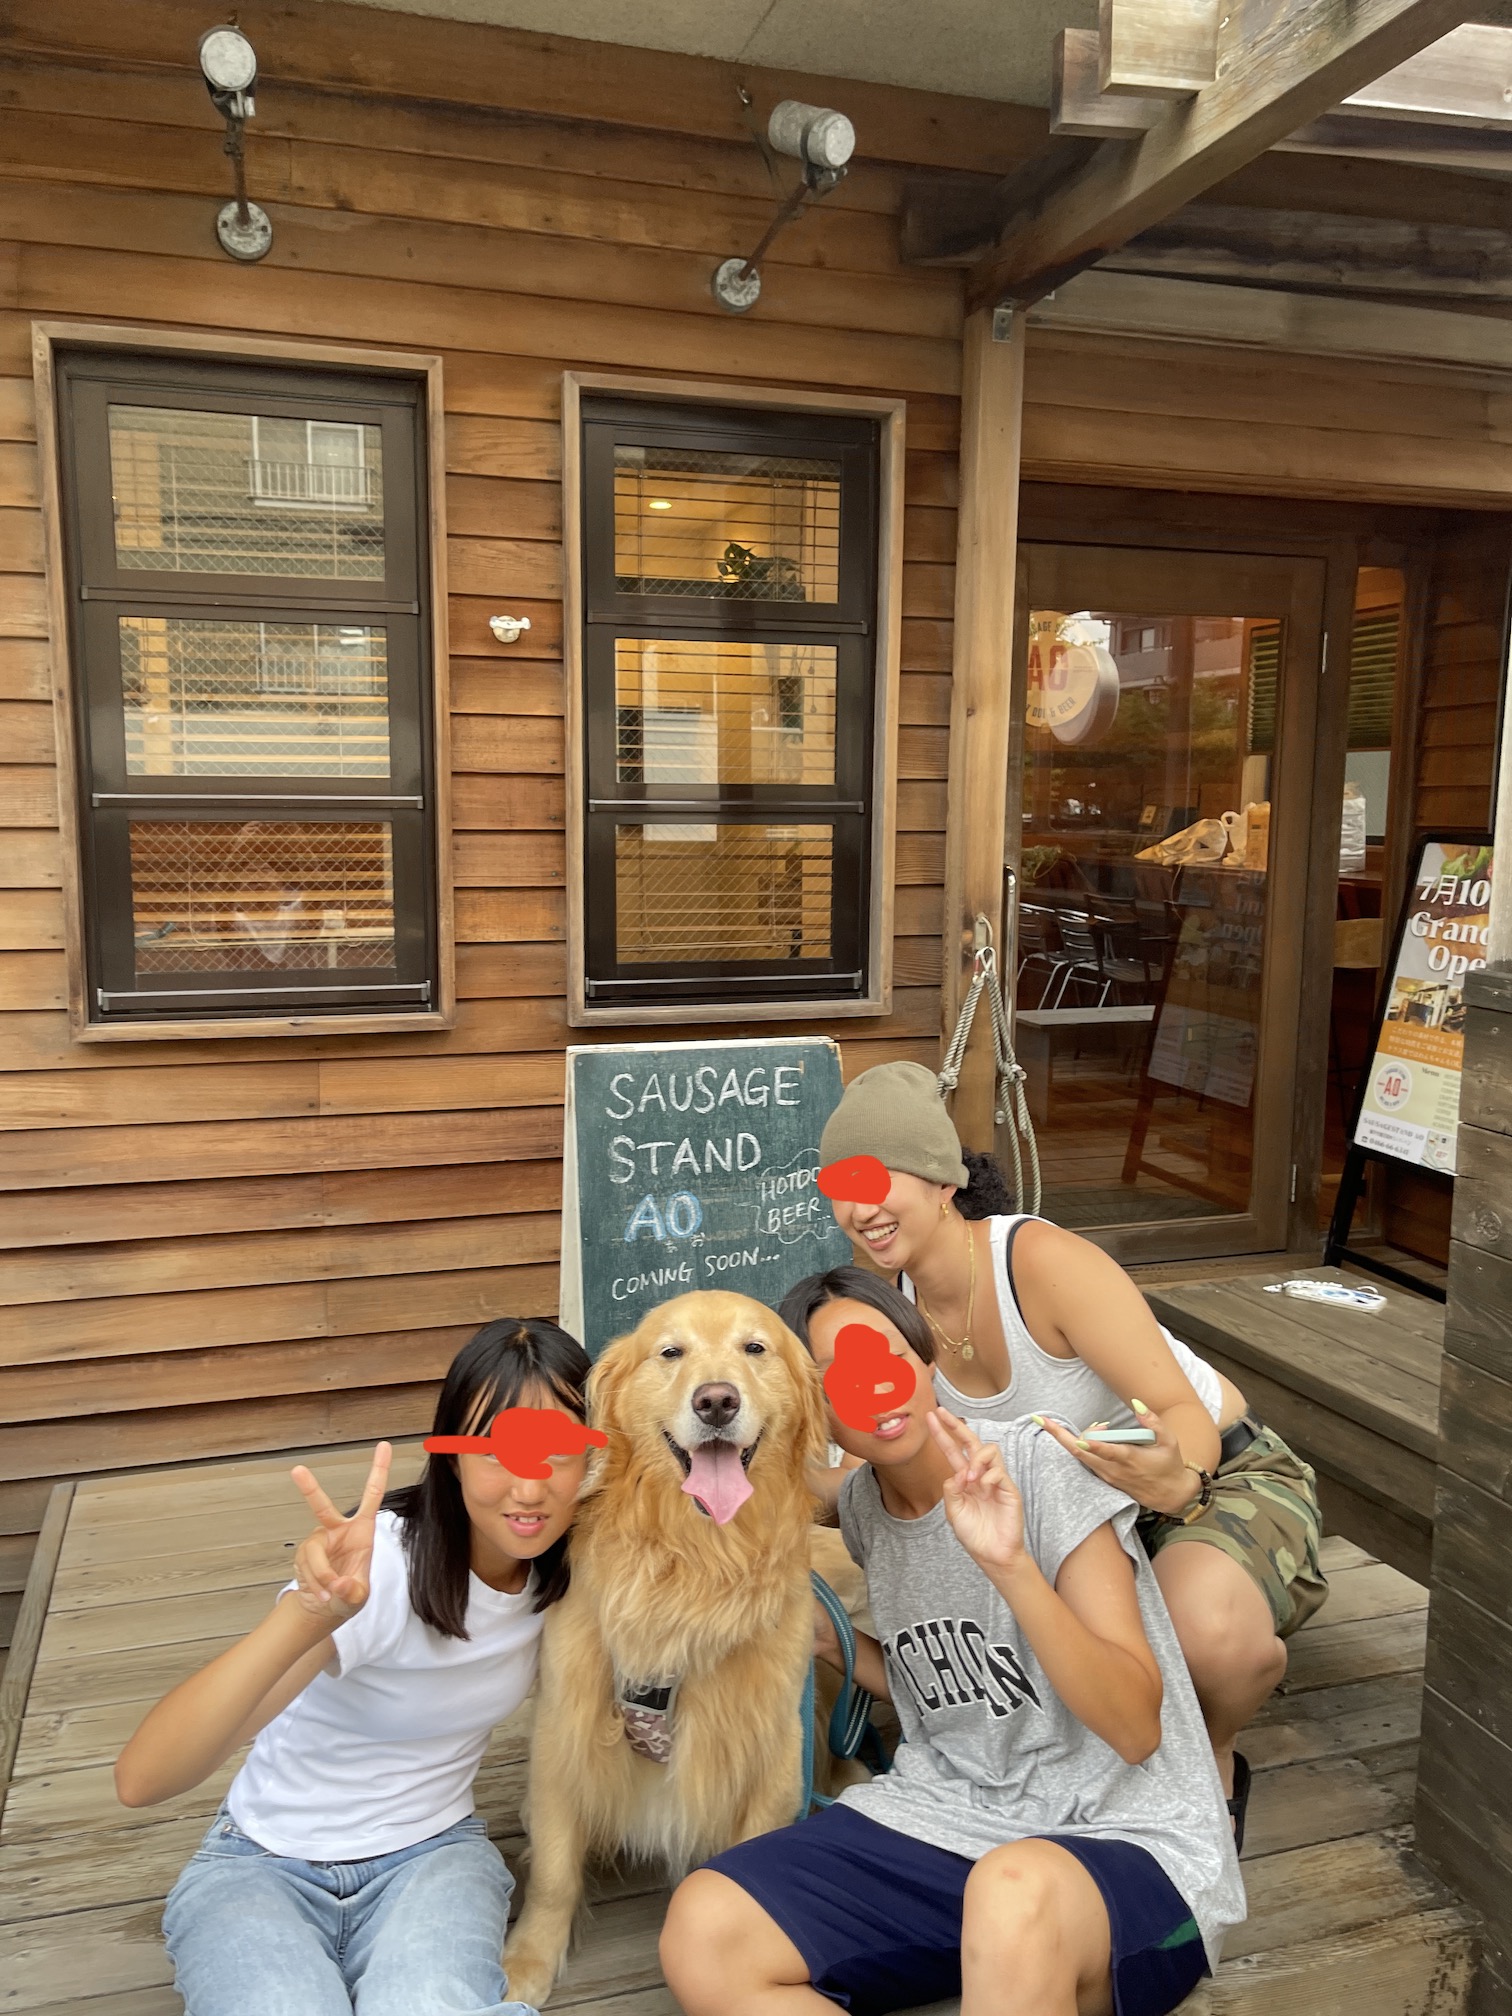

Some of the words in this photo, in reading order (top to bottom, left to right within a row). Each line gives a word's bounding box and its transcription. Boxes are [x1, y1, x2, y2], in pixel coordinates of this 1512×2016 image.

[1418, 874, 1491, 907] 7月10
[1428, 945, 1487, 981] Ope
[605, 1065, 802, 1120] SAUSAGE
[607, 1132, 762, 1184] STAND
[760, 1166, 823, 1202] HOTDO
[623, 1190, 704, 1243] AO
[611, 1261, 695, 1301] COMING
